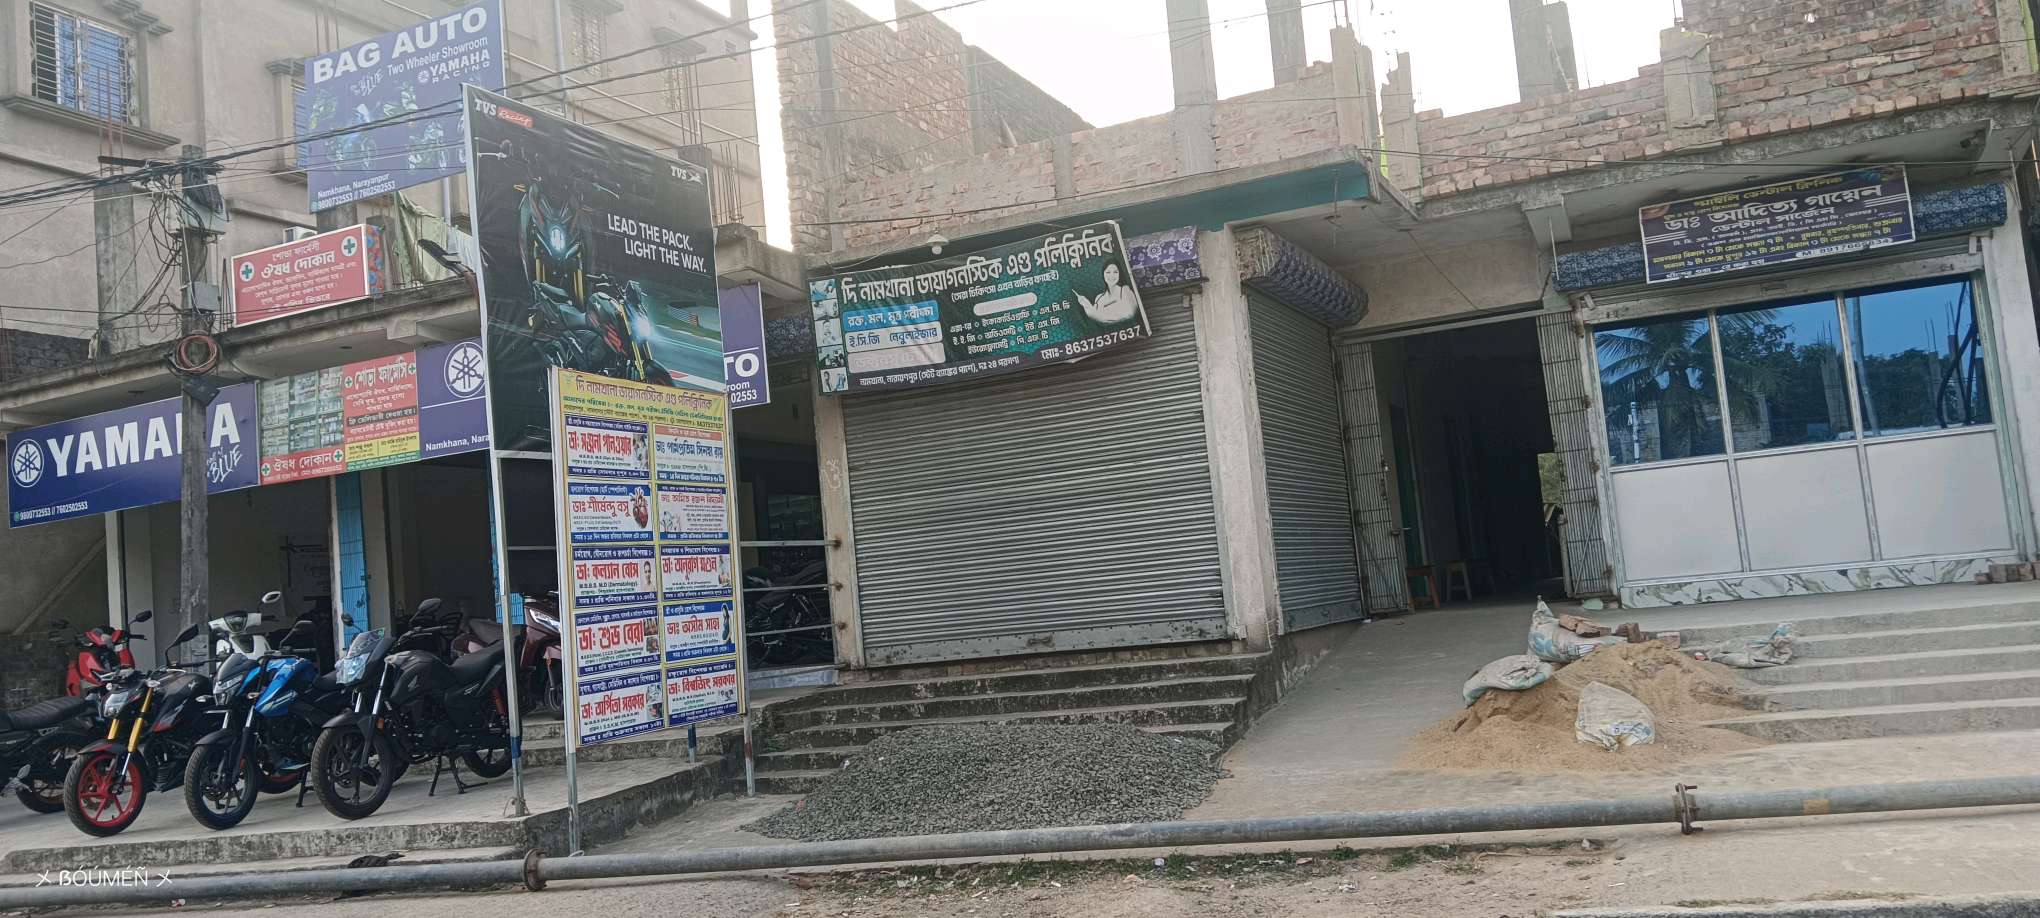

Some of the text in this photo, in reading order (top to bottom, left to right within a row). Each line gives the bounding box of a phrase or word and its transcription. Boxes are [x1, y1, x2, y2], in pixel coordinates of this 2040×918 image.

[313, 7, 487, 84] BAG AUTO
[388, 36, 488, 77] Two Wheeler Showroom
[430, 50, 490, 76] YAMAHA
[432, 61, 490, 84] RACING
[475, 99, 496, 115] TVS
[671, 165, 686, 180] TVS
[1664, 216, 1700, 230] ডাঃ
[1708, 199, 1798, 223] আদিত্য
[1805, 184, 1881, 206] গায়েন
[608, 213, 693, 251] LEAD THE PACK.
[625, 239, 706, 273] LIGHT THE WAY.
[841, 278, 858, 304] দি
[860, 277, 915, 301] নামখানা
[915, 255, 1003, 296] ডায়াগনস্টিক
[1065, 325, 1141, 356] 8637537637
[724, 353, 759, 380] TO
[731, 389, 757, 403] 02553
[47, 403, 240, 478] YAMAA
[426, 439, 469, 451] Namkhana,
